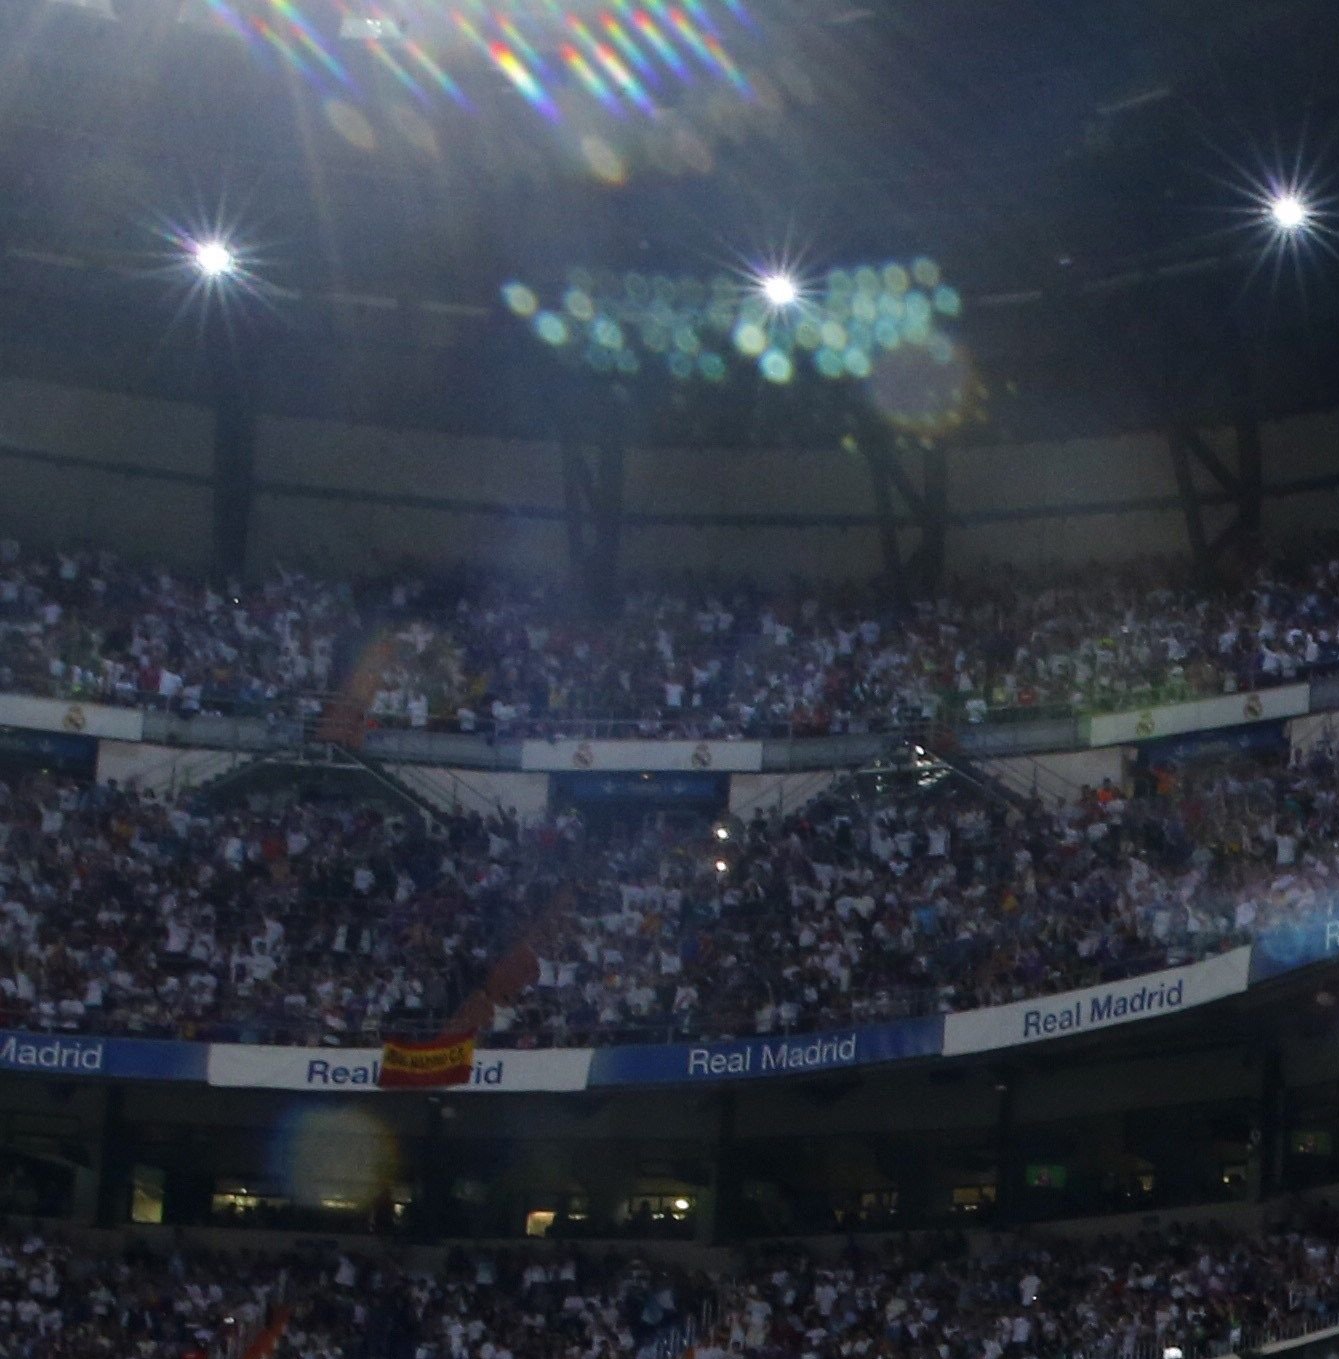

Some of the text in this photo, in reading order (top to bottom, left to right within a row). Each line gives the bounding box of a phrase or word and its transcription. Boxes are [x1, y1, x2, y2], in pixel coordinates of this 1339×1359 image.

[1023, 979, 1184, 1038] Real Madrid
[307, 1059, 380, 1084] Real
[689, 1033, 857, 1076] Real Madrid
